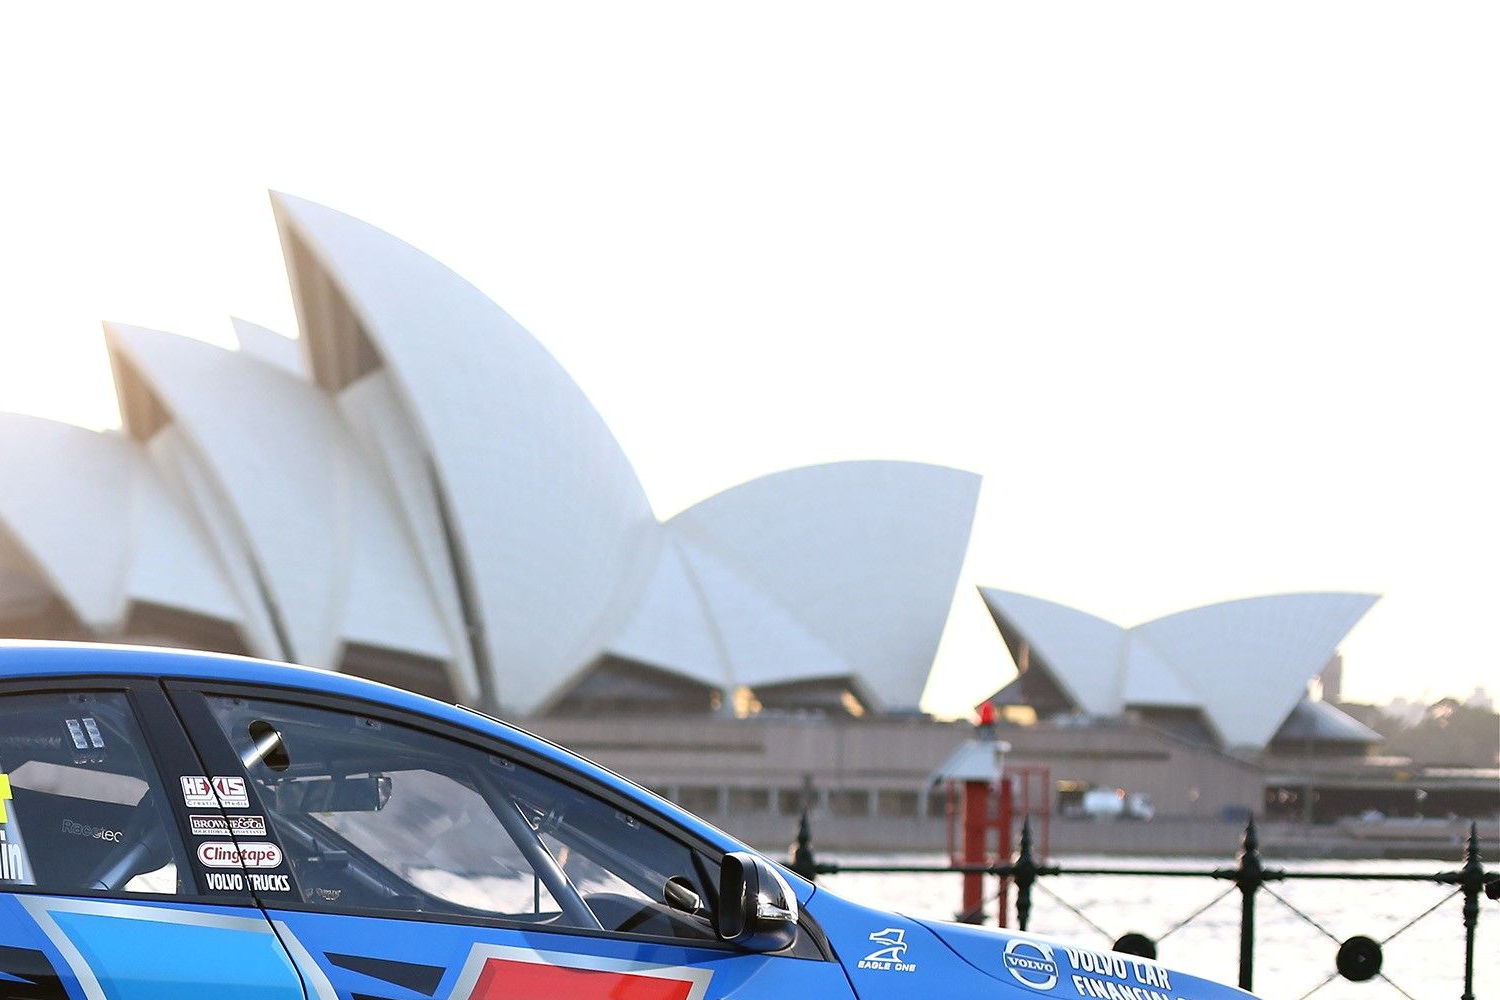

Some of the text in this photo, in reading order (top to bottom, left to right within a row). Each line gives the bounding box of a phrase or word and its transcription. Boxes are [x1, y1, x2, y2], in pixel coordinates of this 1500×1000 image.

[182, 777, 247, 800] HEXIS
[203, 847, 276, 866] Clingtape
[206, 873, 291, 892] VOLVO TRUCKS
[857, 960, 917, 972] EAGLE ONE
[1007, 956, 1054, 973] VOLVO
[1063, 947, 1172, 991] VOLVO CAR
